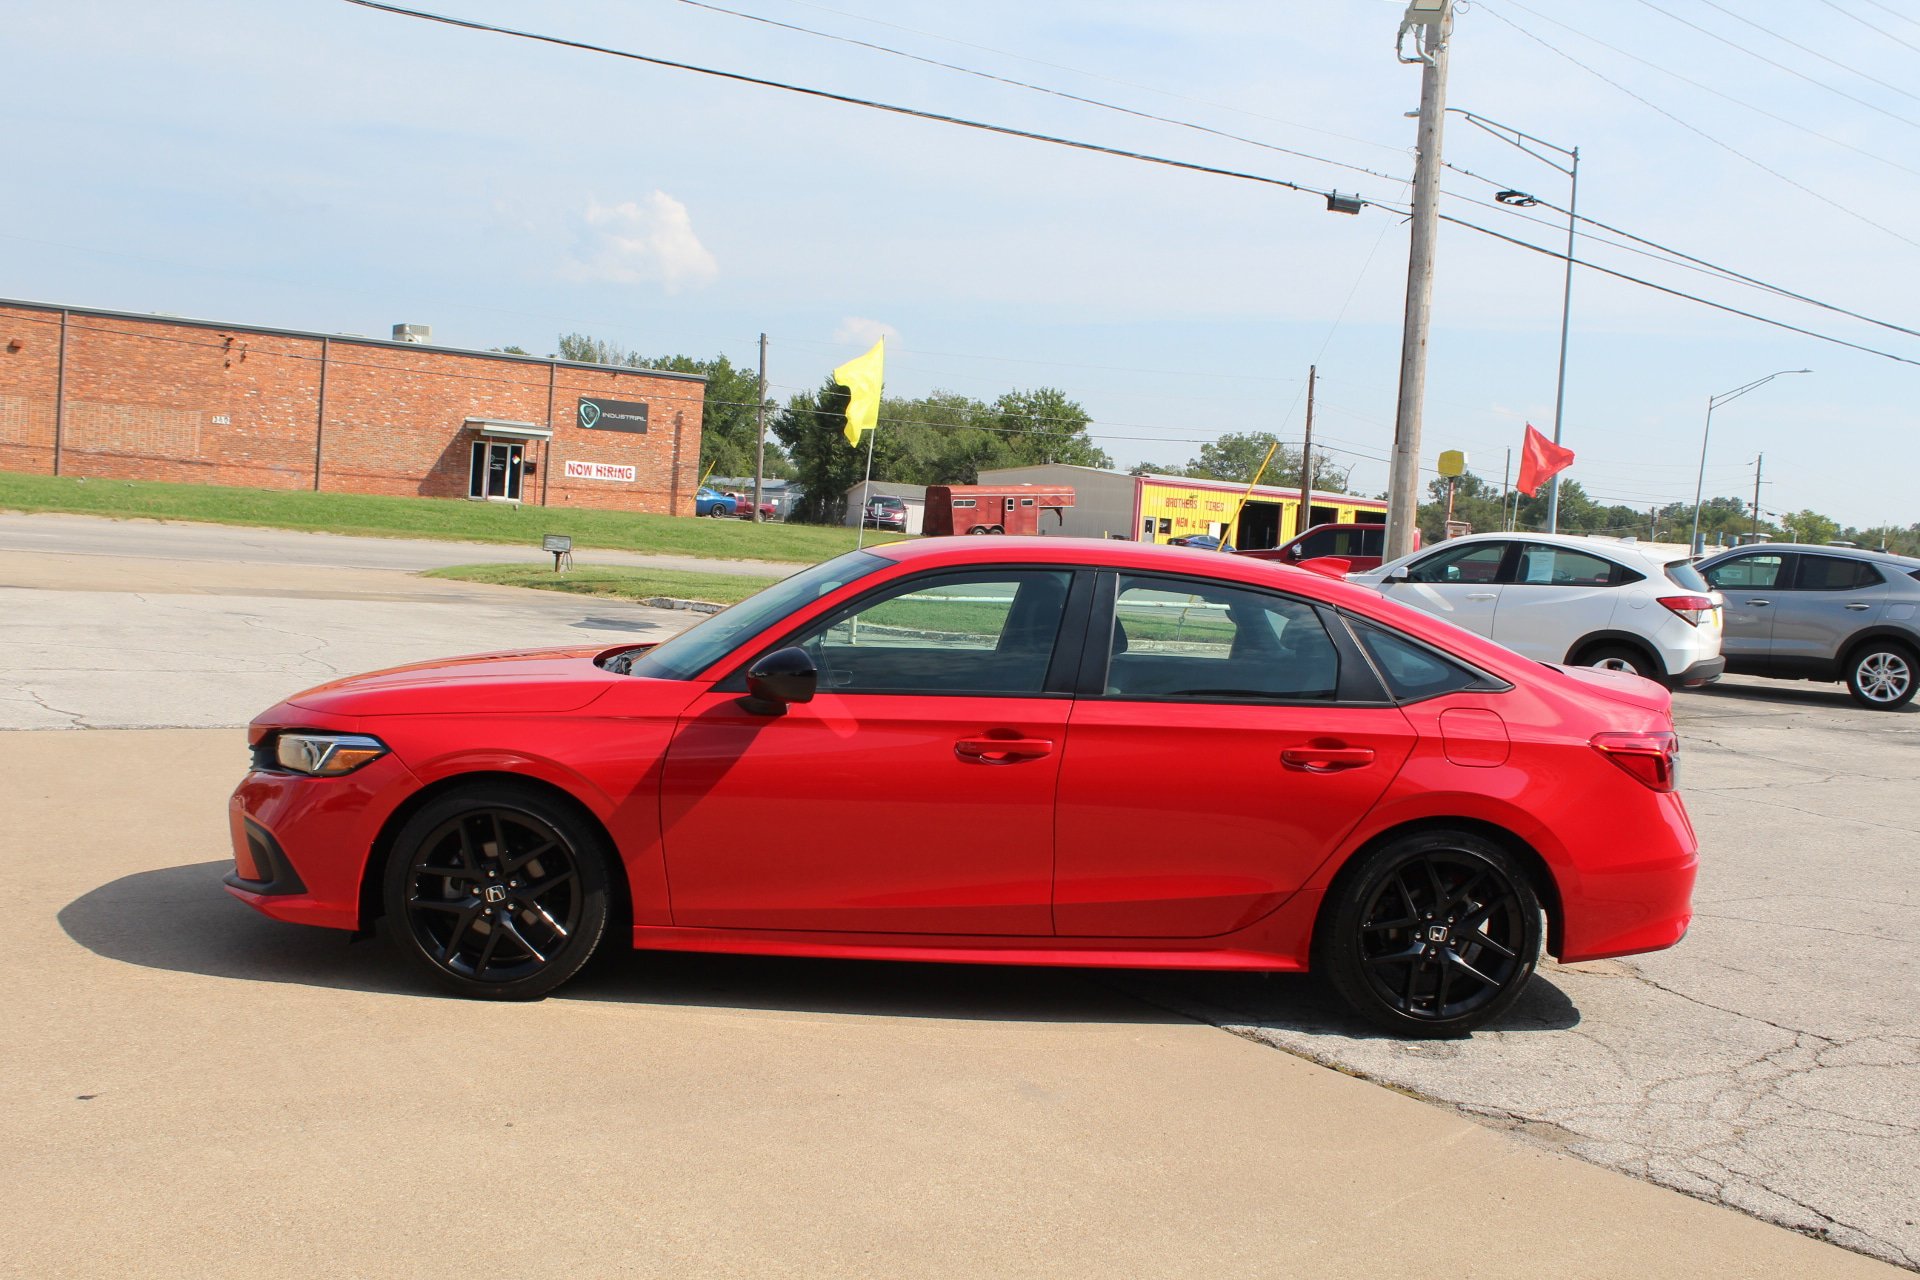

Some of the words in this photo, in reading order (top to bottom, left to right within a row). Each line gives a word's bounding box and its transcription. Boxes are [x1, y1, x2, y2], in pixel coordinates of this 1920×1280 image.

[602, 412, 646, 422] INDUSTRIAL
[568, 463, 592, 476] NOW
[596, 465, 632, 479] HIRING
[1166, 497, 1197, 509] BROTHERS
[1205, 501, 1224, 511] TIRES
[1176, 517, 1188, 528] NEW
[1199, 519, 1215, 528] US
